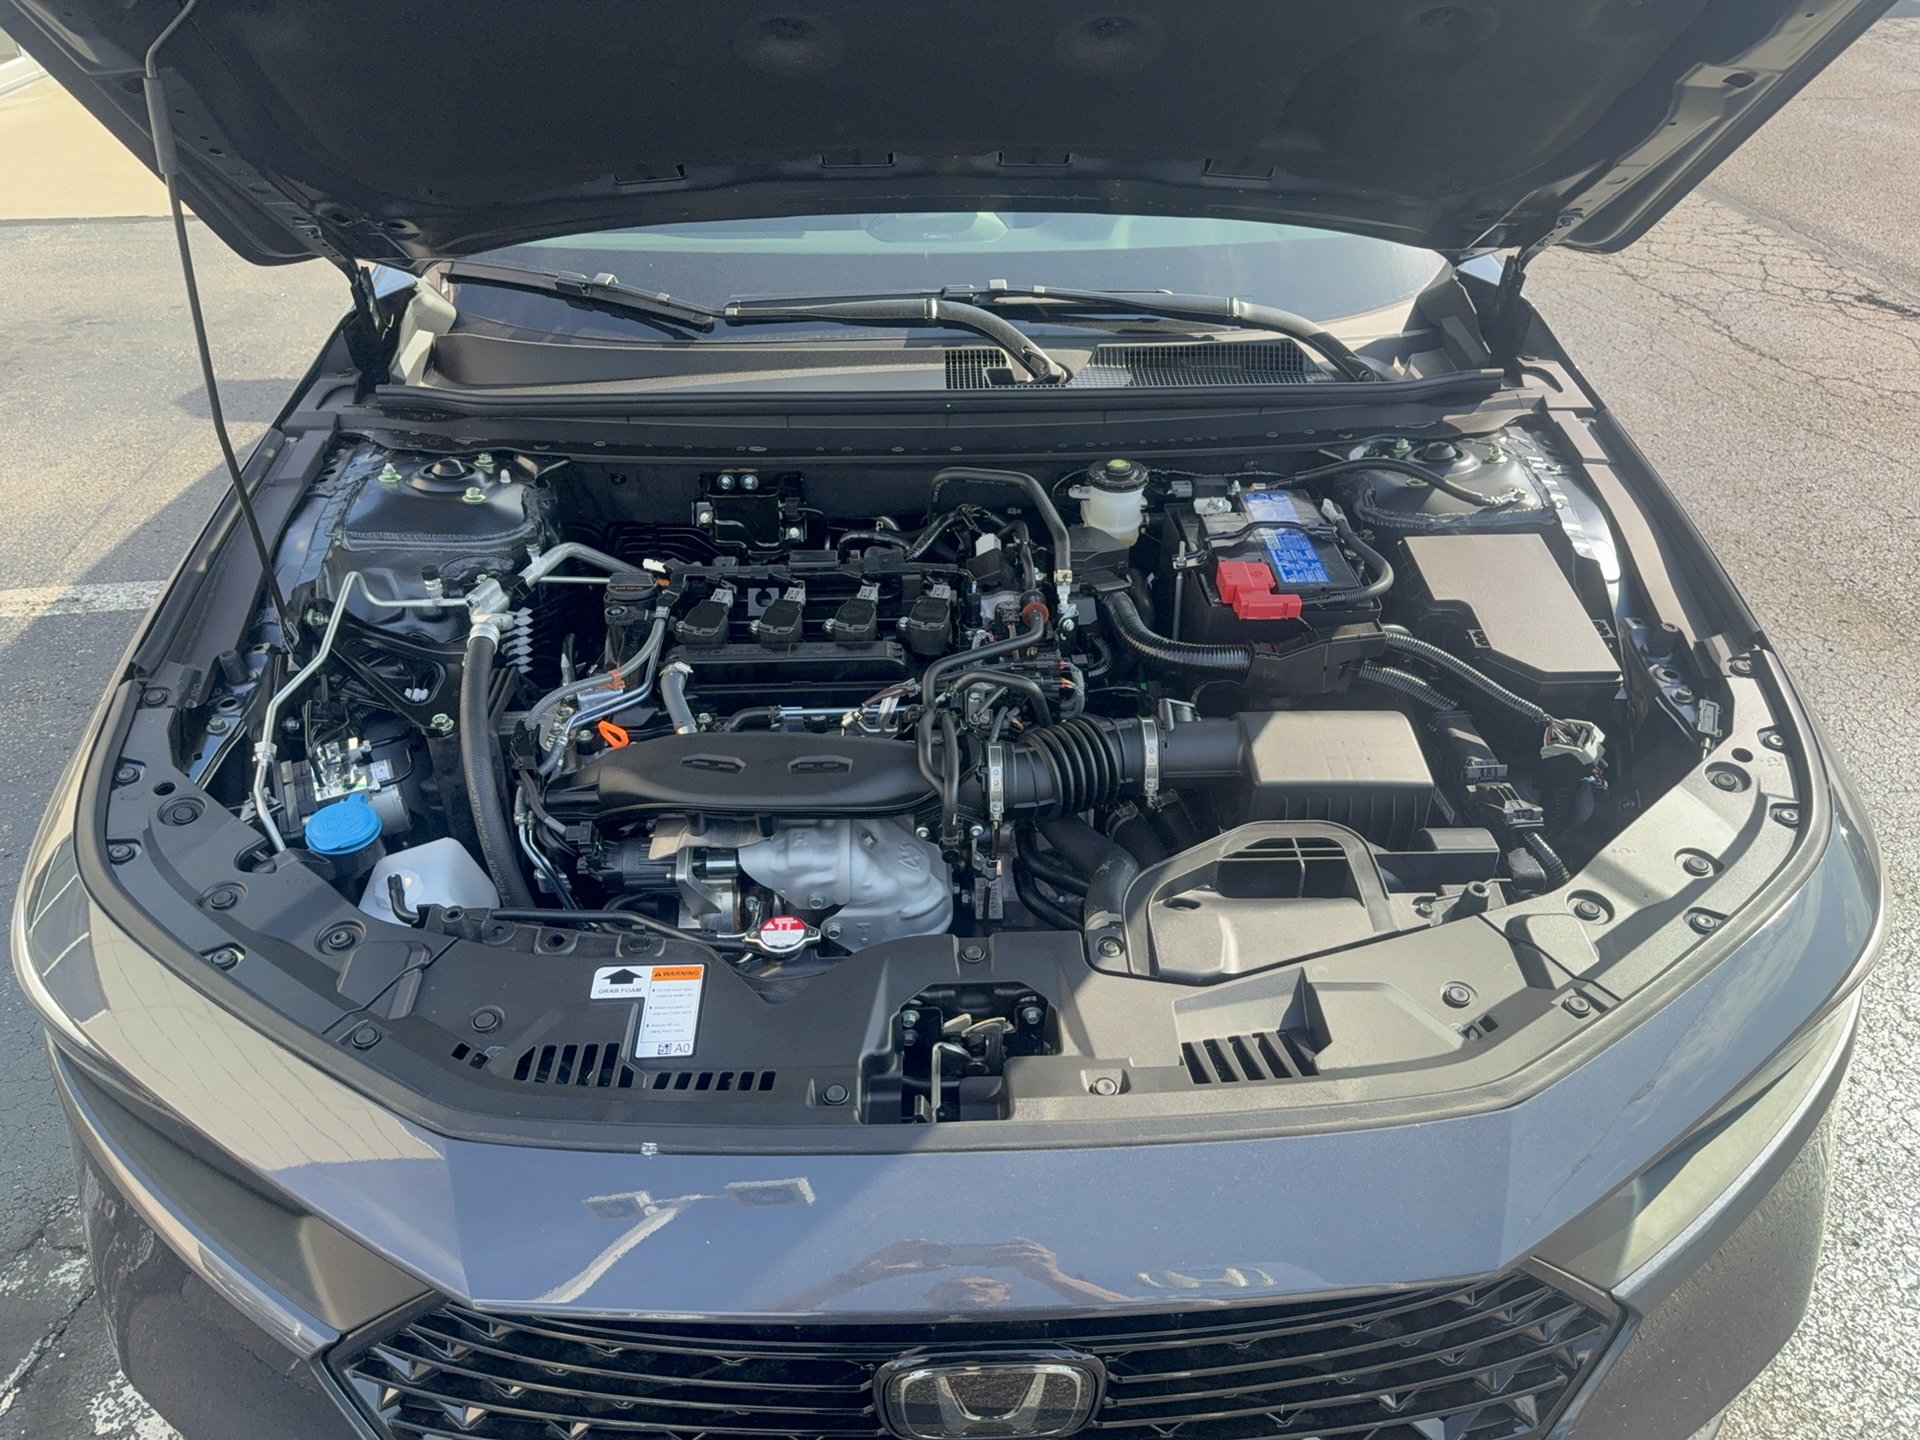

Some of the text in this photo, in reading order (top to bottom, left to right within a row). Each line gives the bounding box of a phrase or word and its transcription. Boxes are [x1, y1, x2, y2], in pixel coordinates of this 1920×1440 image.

[598, 986, 642, 995] GRAB FOAM
[673, 1042, 691, 1053] A0
